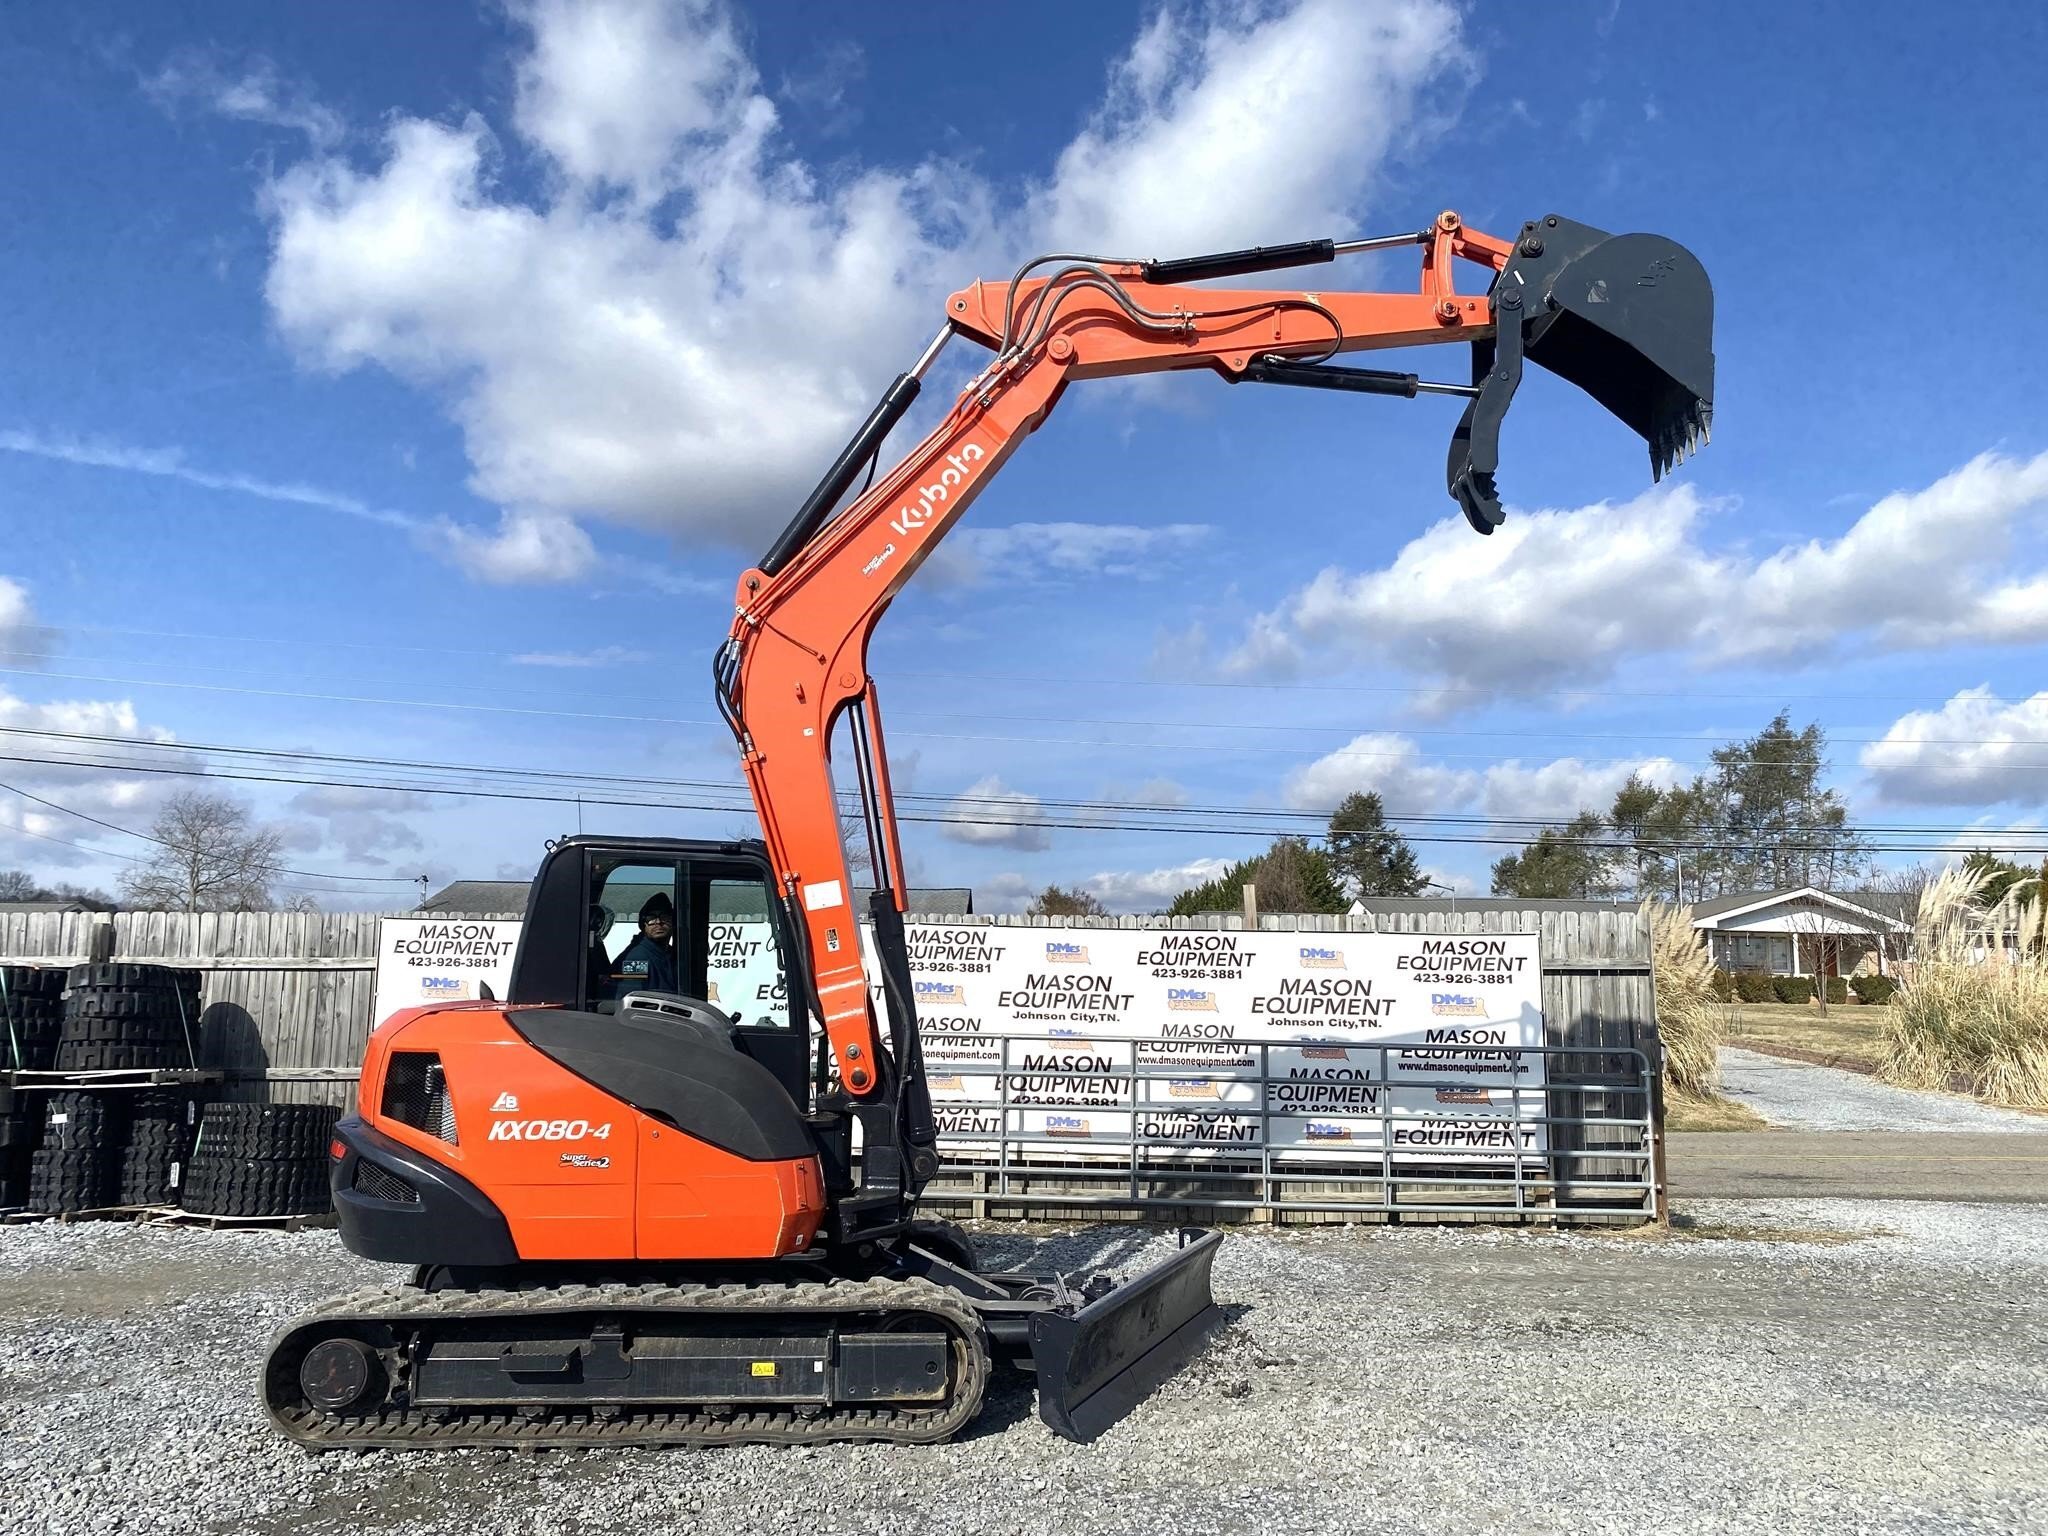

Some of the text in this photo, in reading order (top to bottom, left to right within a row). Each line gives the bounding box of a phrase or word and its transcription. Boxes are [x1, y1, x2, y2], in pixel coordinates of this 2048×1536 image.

[890, 444, 984, 536] Kubota
[418, 925, 495, 940] MASON
[909, 929, 987, 945] MASON
[393, 940, 513, 956] EQUIPMENT
[1160, 936, 1237, 951] MASON
[1422, 941, 1506, 955] MASON
[407, 957, 498, 968] 423-926-3881
[1137, 951, 1256, 967] EQUIPMENT
[1396, 956, 1528, 971] EQUIPMENT
[909, 962, 991, 973] 23-926-3881
[1152, 968, 1242, 979] 423-926-3881
[1025, 974, 1112, 992] MASON
[1413, 973, 1513, 984] 423-926-3881
[1280, 978, 1372, 996] MASON
[998, 991, 1134, 1011] EQUIPMENT
[1251, 997, 1396, 1016] EQUIPMENT
[1012, 1011, 1066, 1020] Johnson
[1267, 1018, 1324, 1027] Johnson
[1161, 1023, 1235, 1039] MASON
[1425, 1029, 1506, 1044] MASON
[1022, 1054, 1112, 1073] MASON
[487, 1120, 612, 1141] KX080-4
[560, 1153, 588, 1164] Super
